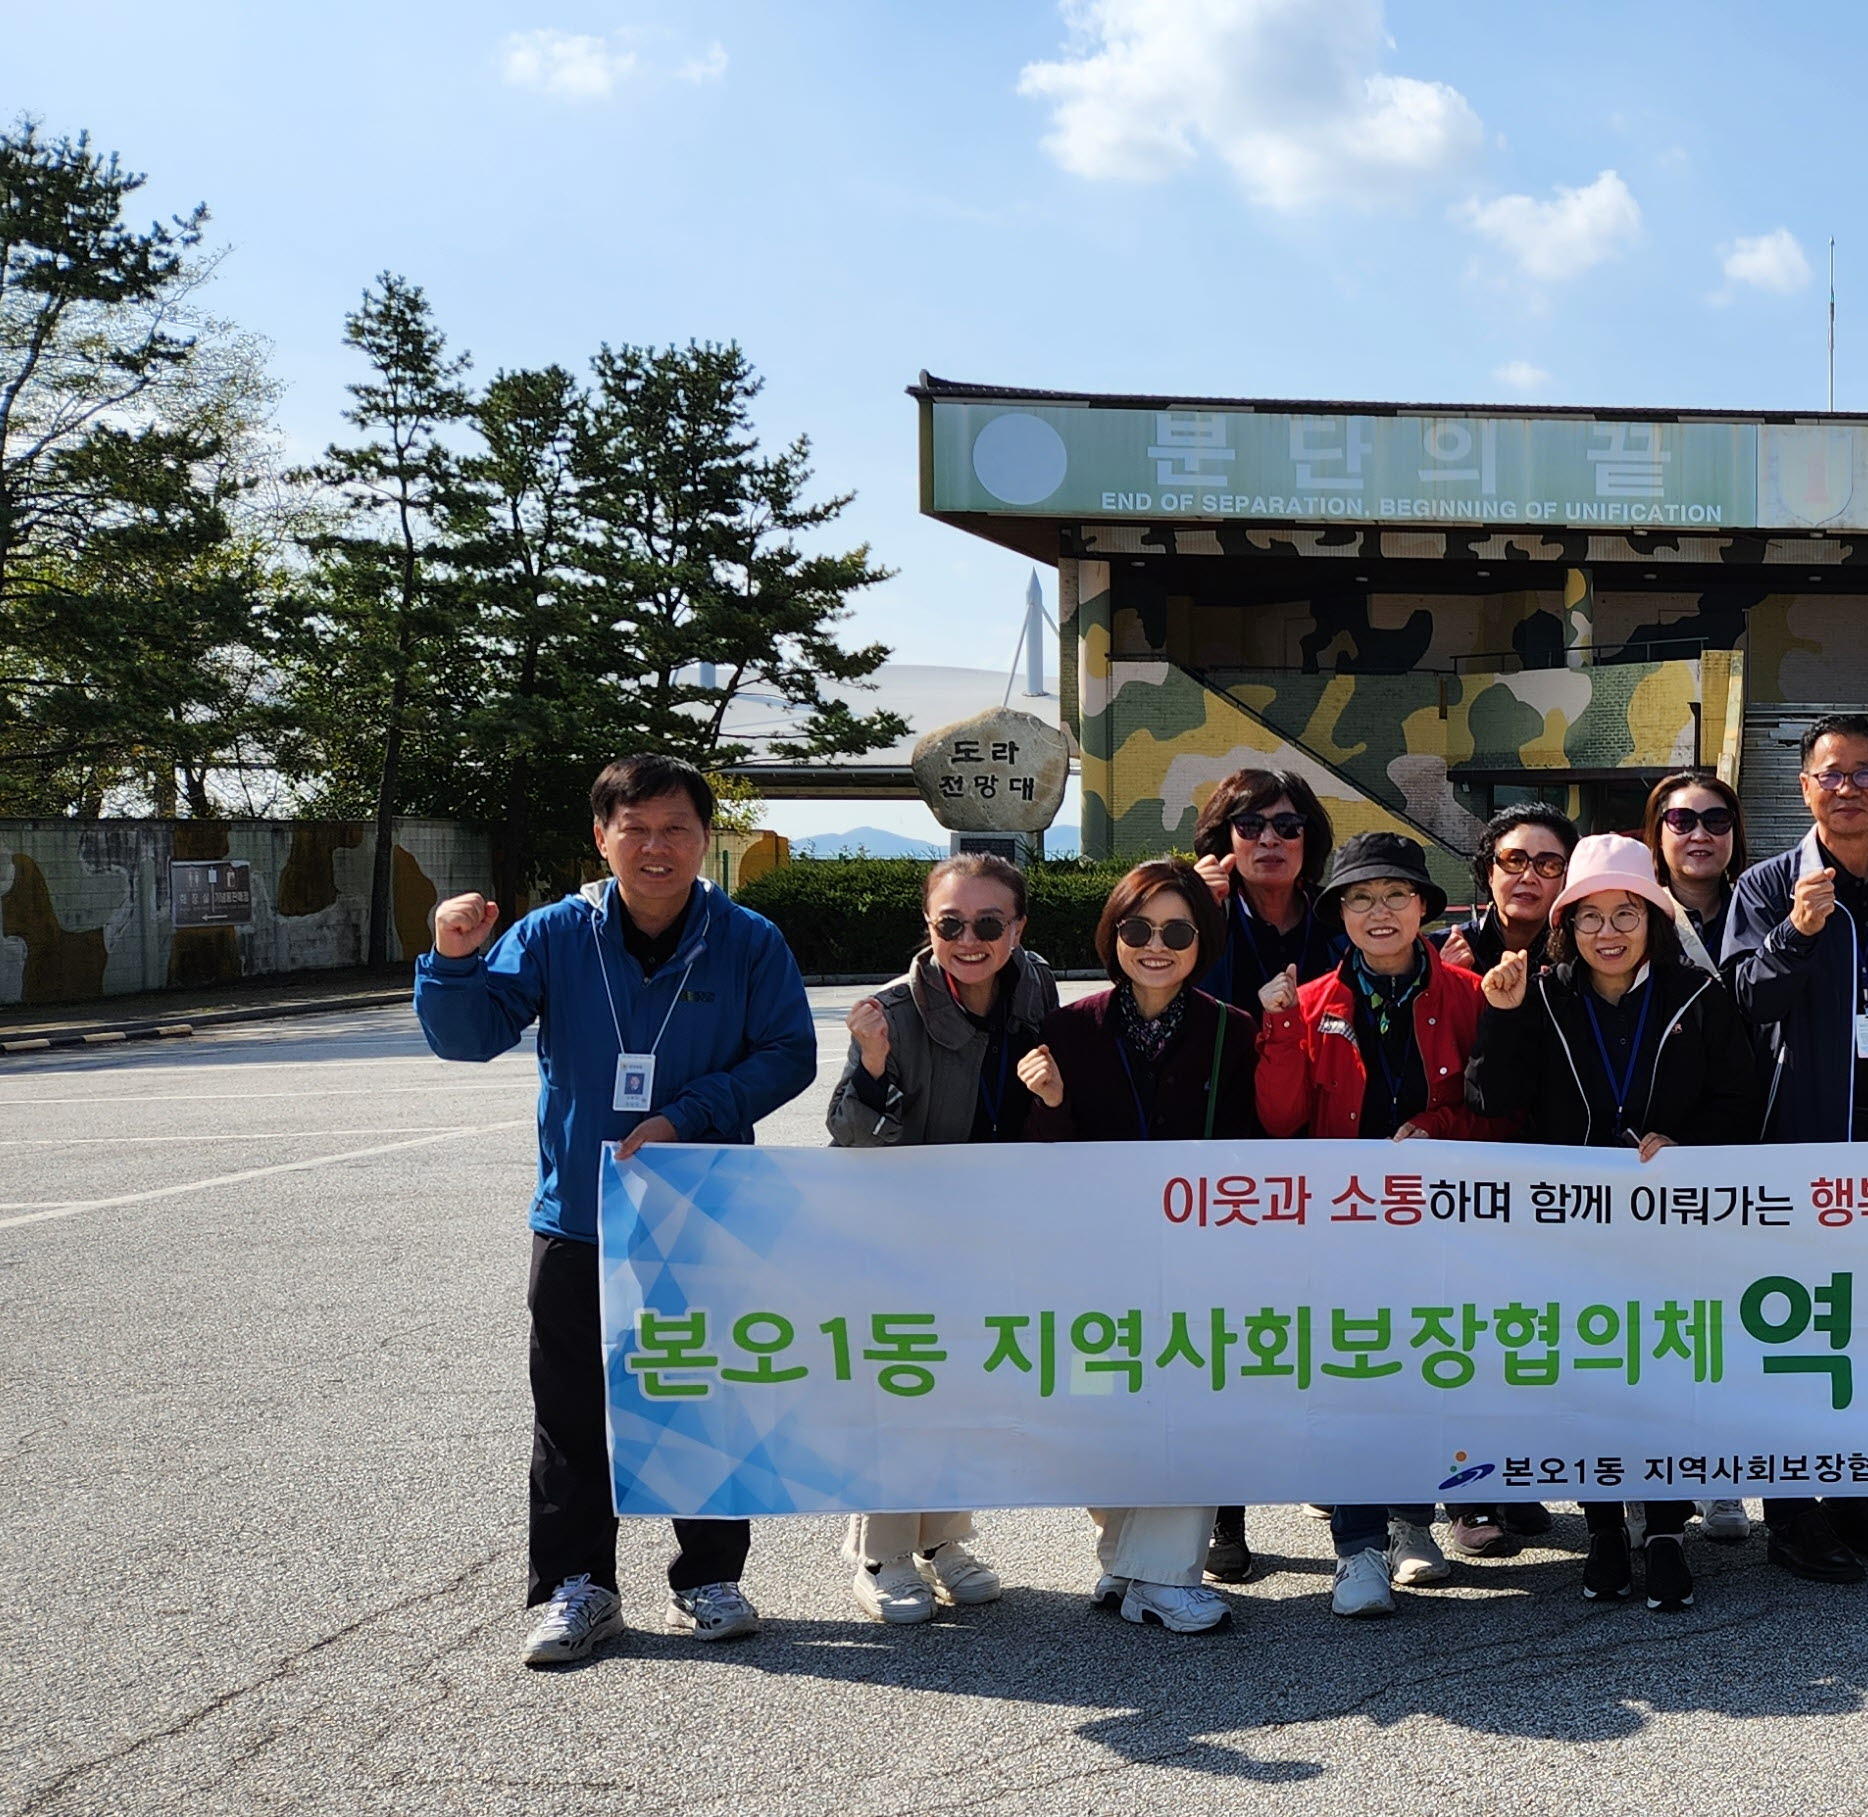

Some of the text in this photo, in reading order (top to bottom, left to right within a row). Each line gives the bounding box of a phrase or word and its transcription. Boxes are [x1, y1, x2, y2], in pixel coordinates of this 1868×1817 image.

[1147, 413, 1672, 498] 분단의 끝
[1101, 491, 1723, 523] END OF SEPARATION, BEGINNING OF UNIFICATION
[951, 740, 1020, 765] 도라
[938, 774, 1035, 801] 전망대
[1162, 1174, 1313, 1228] 이웃과
[1330, 1174, 1511, 1226] 소통하며
[1529, 1181, 1612, 1225] 함께
[1630, 1185, 1794, 1227] 이뤄가는
[630, 1311, 948, 1397] 본오1동
[983, 1299, 1723, 1397] 지역사회보장협의체
[1501, 1456, 1626, 1487] 본오1동
